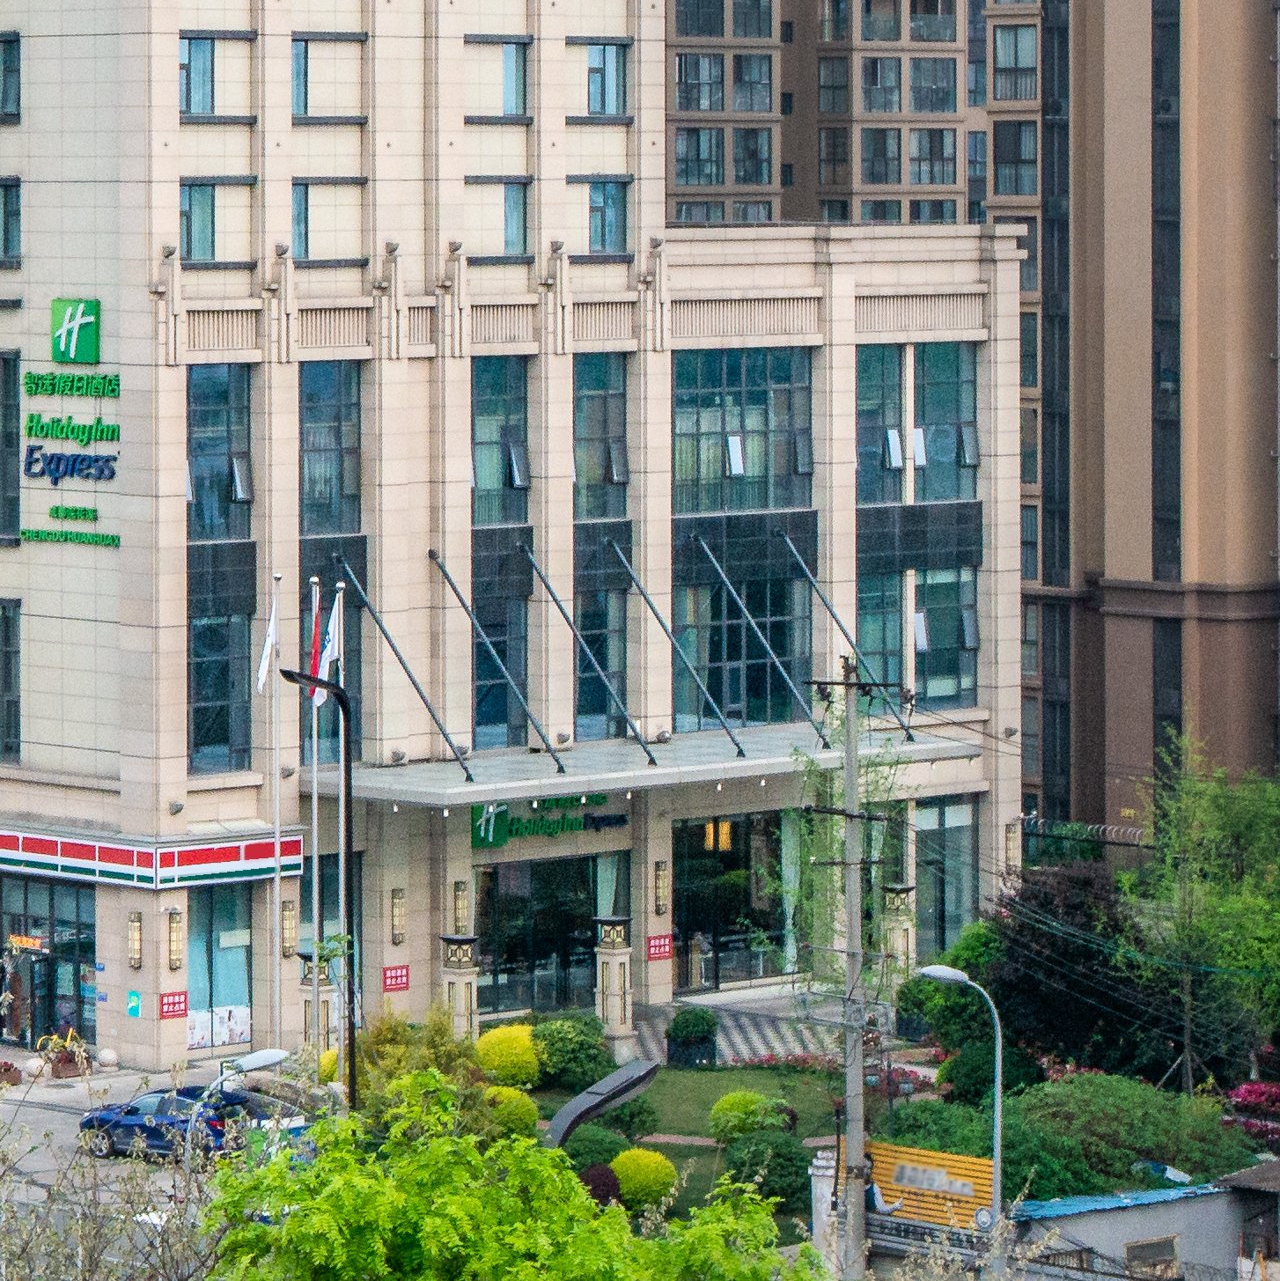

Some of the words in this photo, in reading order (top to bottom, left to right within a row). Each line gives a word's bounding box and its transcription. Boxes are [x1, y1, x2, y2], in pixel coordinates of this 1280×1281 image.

[24, 372, 120, 398] 智选假日酒店
[24, 413, 91, 446] Holiday
[93, 416, 120, 442] Inn
[24, 445, 118, 485] Express
